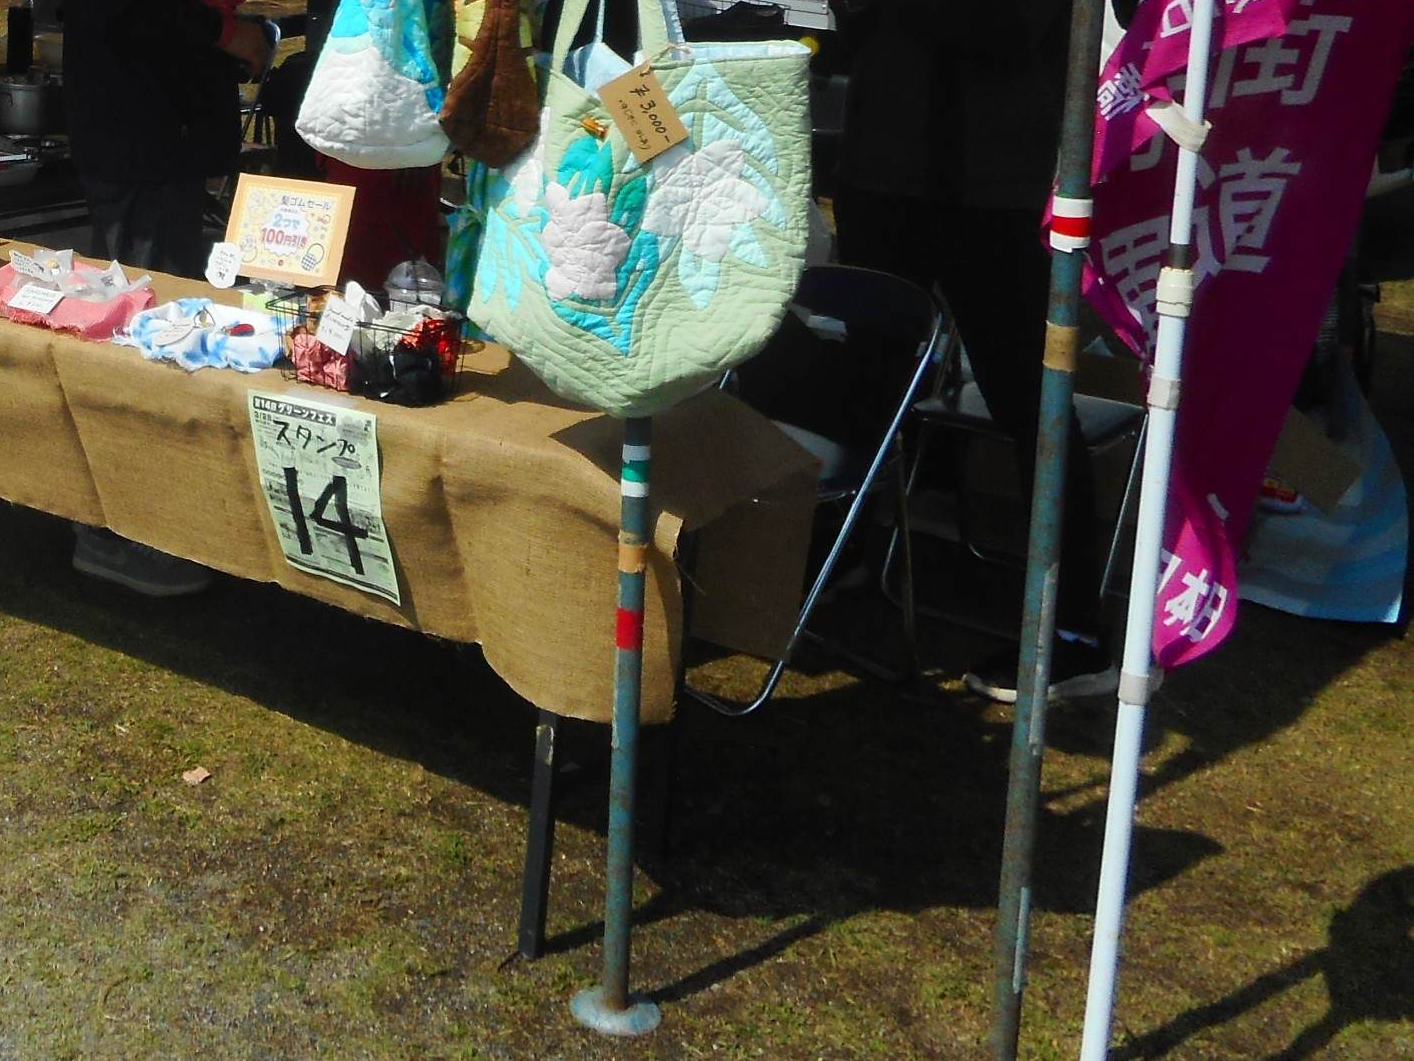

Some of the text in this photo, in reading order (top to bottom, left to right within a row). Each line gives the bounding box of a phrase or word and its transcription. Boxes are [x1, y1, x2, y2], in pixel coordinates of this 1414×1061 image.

[273, 420, 356, 457] スタンプ
[282, 467, 369, 576] 14
